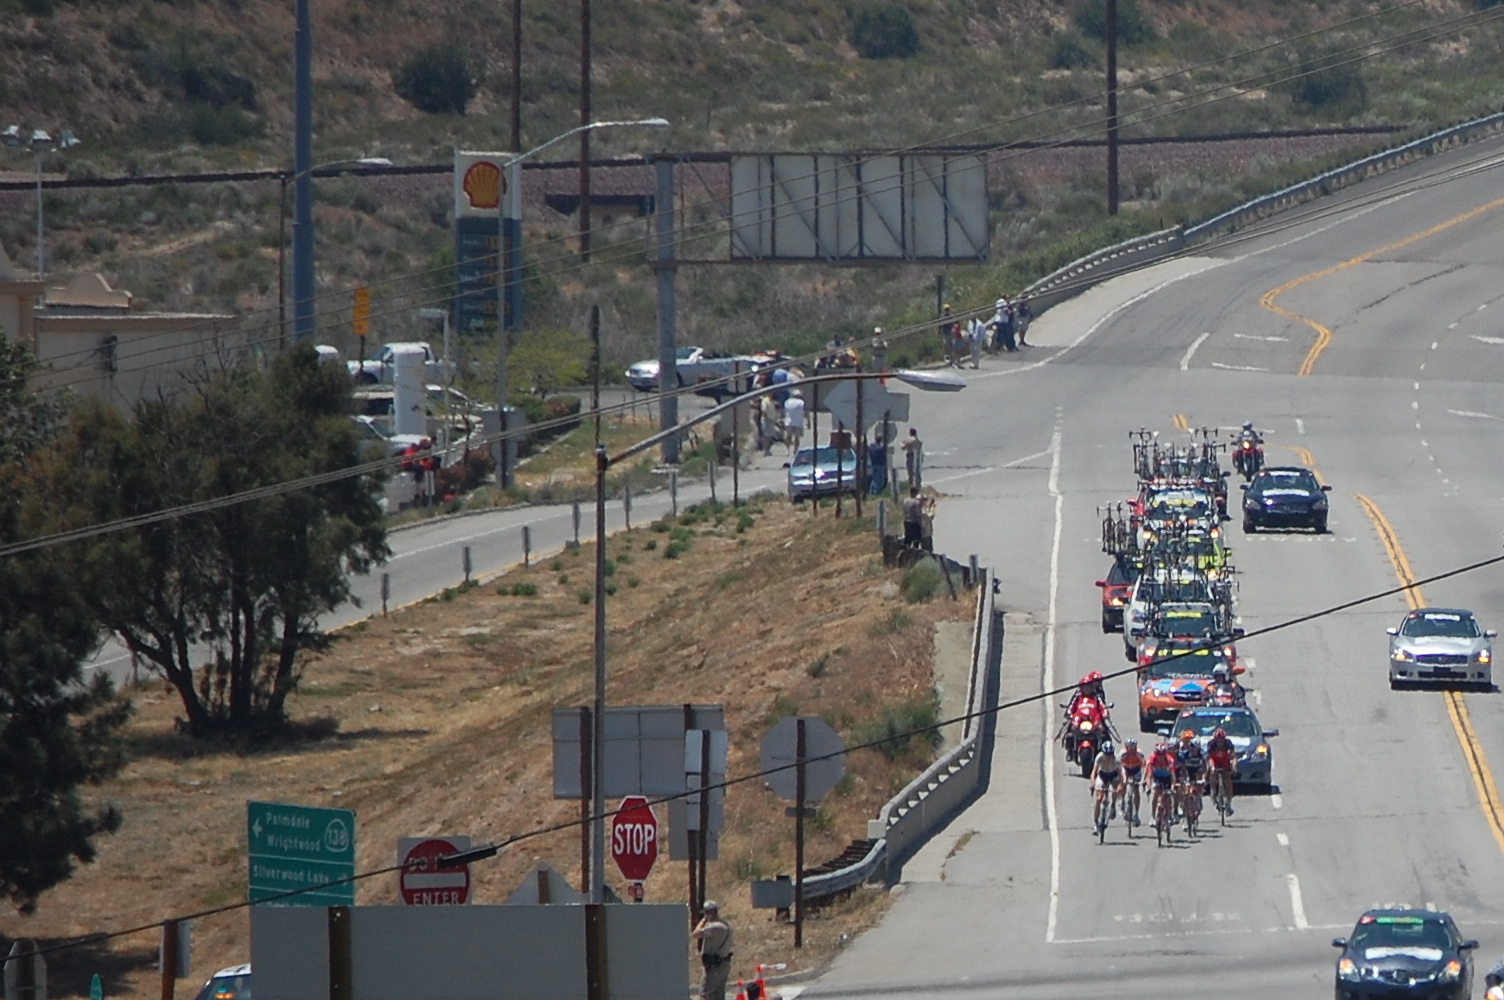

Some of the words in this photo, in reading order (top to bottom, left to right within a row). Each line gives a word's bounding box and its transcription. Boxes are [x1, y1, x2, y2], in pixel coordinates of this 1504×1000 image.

[266, 812, 310, 829] Palmdale
[267, 834, 321, 852] Wrightwood
[328, 828, 346, 846] 138
[614, 823, 654, 856] STOP
[253, 865, 304, 882] Silverwood
[307, 871, 329, 884] Lake
[413, 892, 459, 906] ENTER
